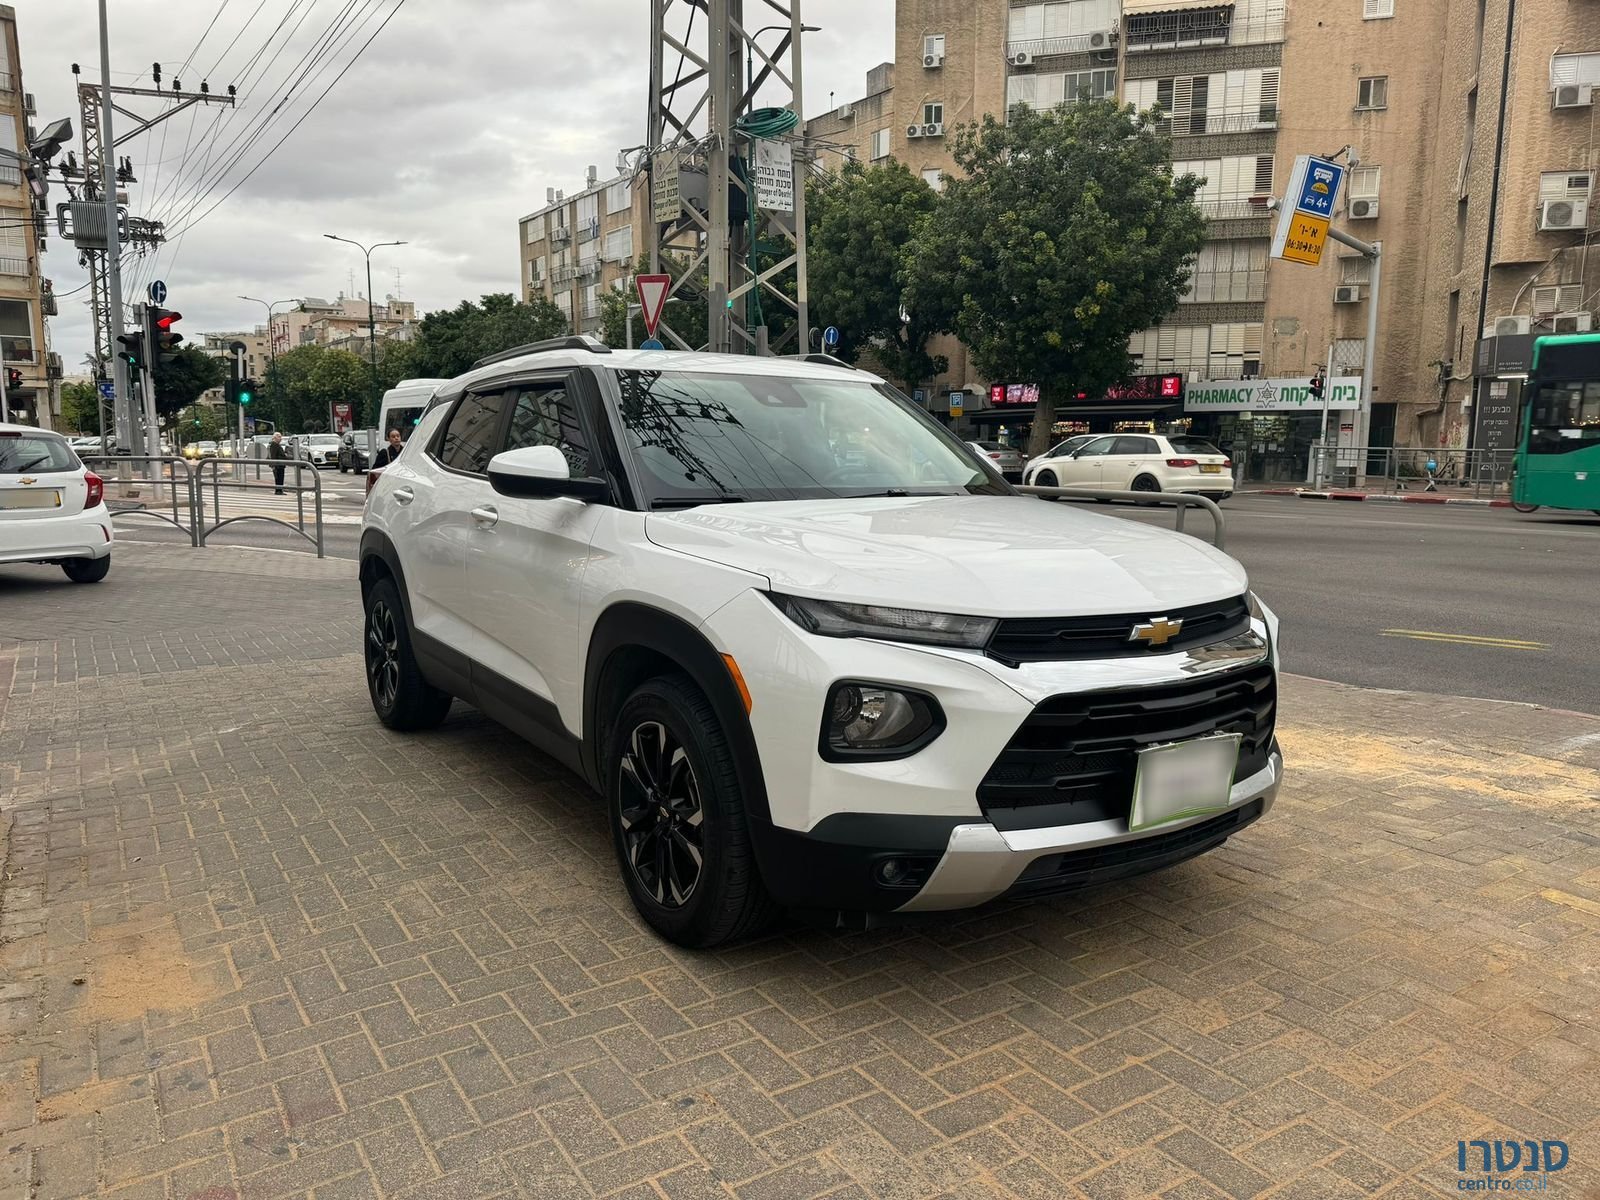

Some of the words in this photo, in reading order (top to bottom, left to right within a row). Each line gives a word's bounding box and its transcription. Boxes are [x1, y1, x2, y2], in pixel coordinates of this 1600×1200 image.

[777, 169, 791, 179] מתח
[775, 179, 791, 189] סכנת
[1188, 388, 1253, 404] PHARMACY
[1331, 385, 1357, 401] בית
[1491, 406, 1511, 414] מבצע
